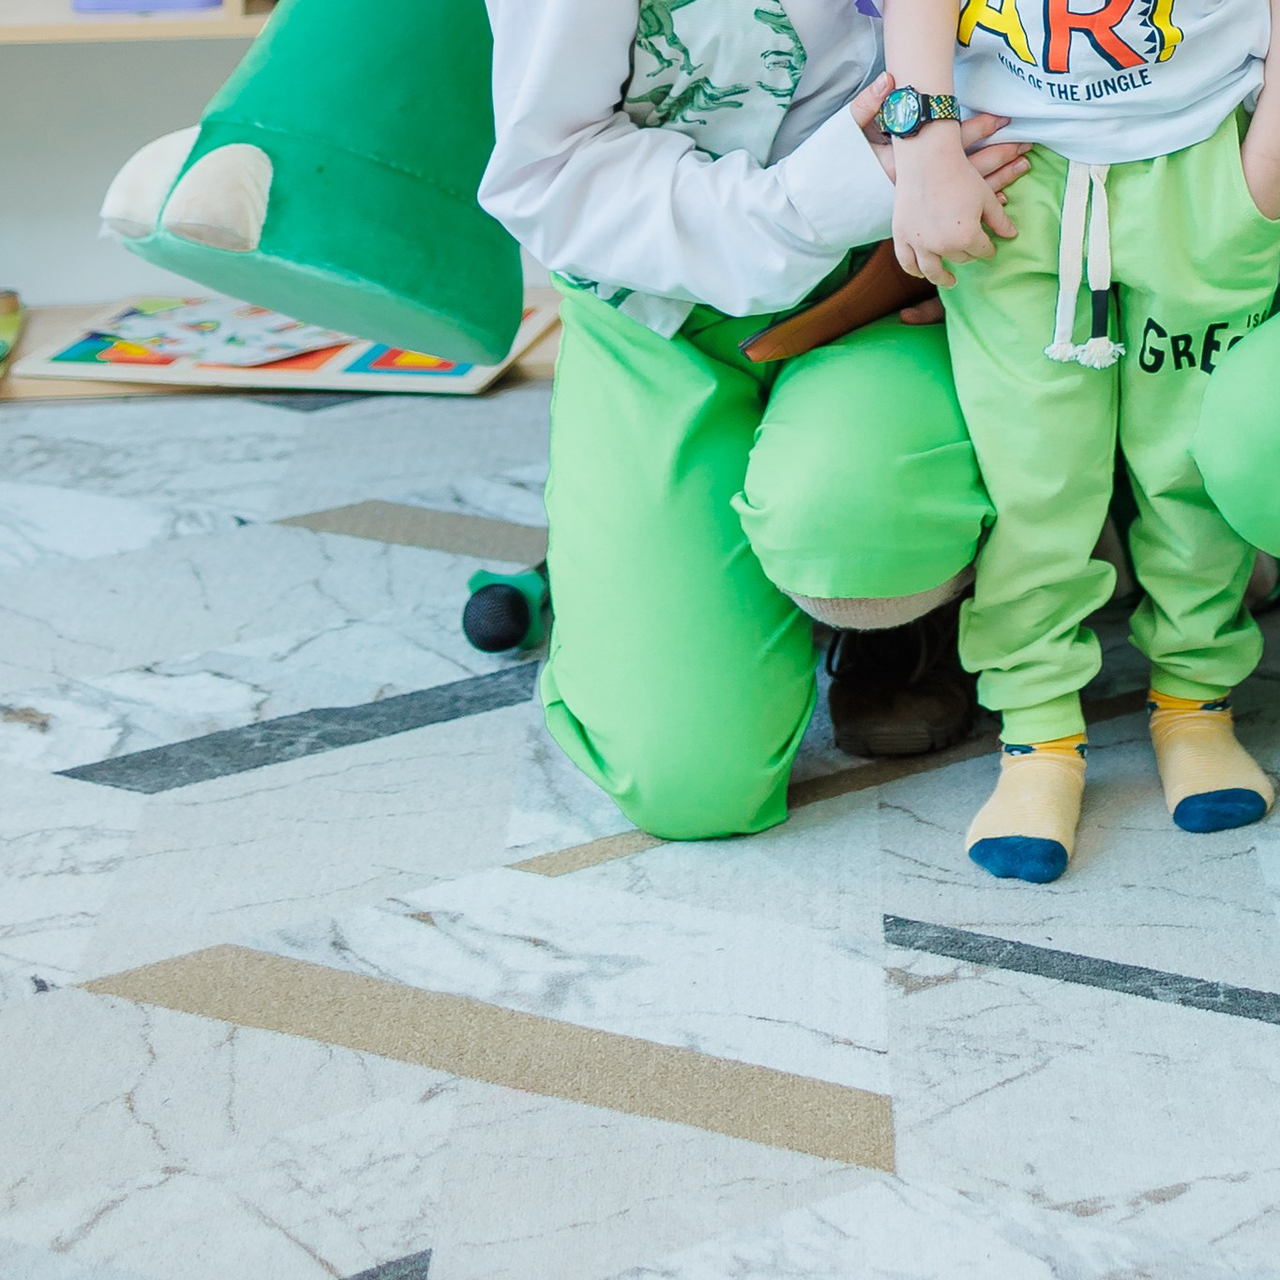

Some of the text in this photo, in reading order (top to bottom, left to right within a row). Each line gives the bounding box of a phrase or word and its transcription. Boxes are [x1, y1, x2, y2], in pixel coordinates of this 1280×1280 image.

[1047, 82, 1081, 102] THE
[1085, 68, 1152, 101] JUNGLE
[1139, 317, 1244, 376] GRE
